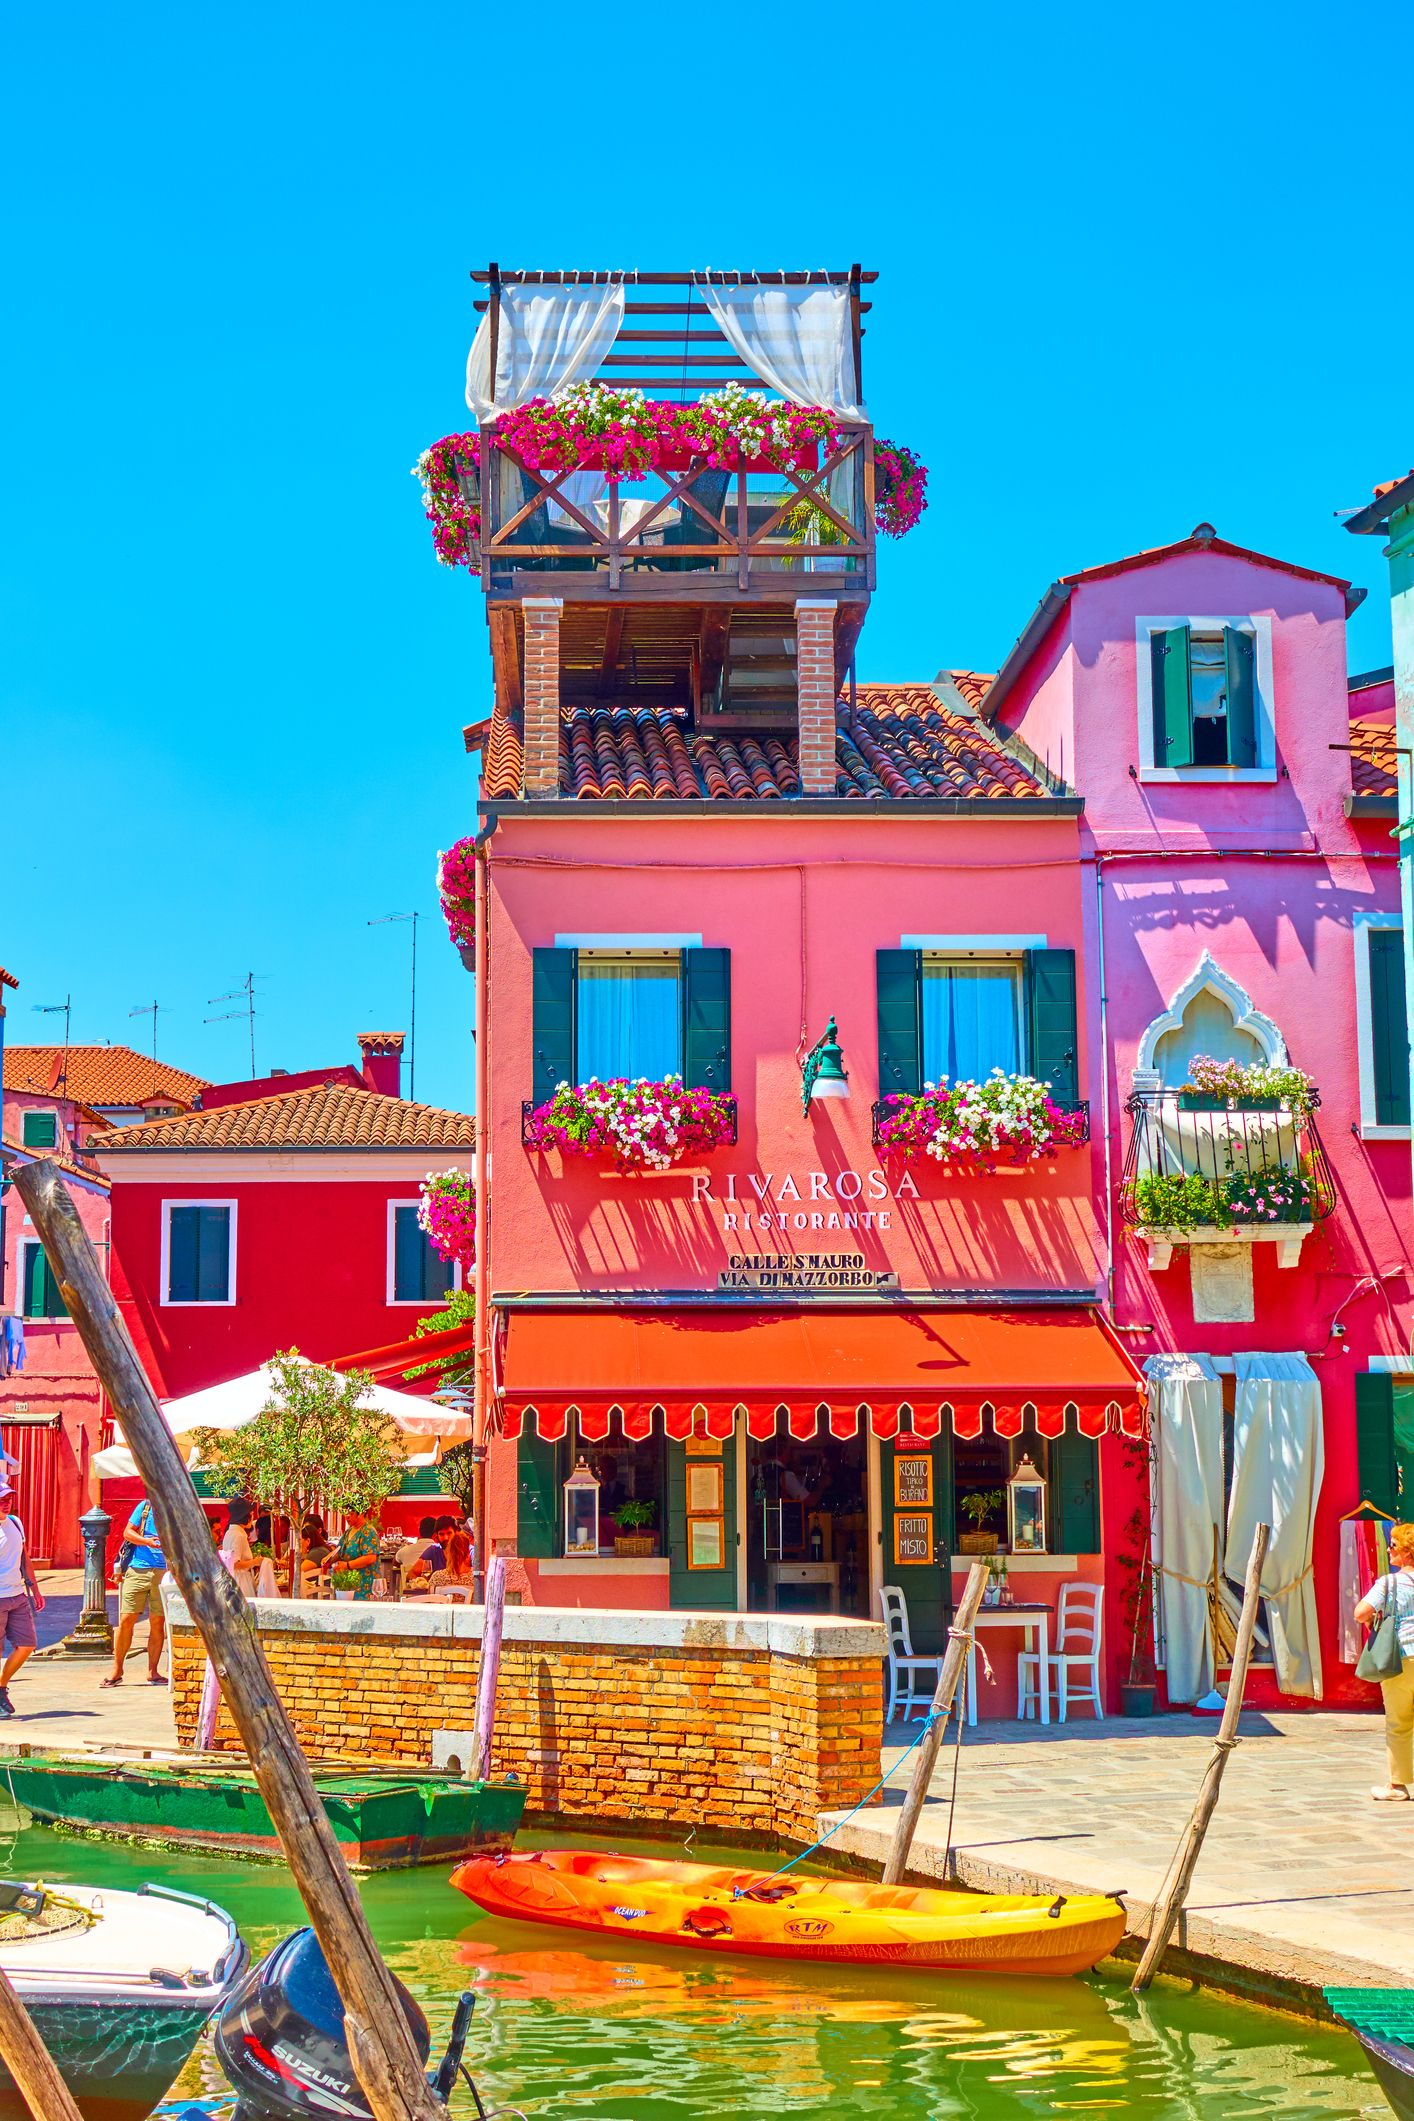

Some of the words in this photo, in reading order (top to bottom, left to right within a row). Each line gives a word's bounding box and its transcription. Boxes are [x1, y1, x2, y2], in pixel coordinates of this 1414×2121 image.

[690, 1170, 921, 1202] RIVAROSA
[723, 1212, 892, 1230] RISTORANTE
[729, 1255, 789, 1269] CALLE
[720, 1272, 750, 1286] VIA
[759, 1272, 778, 1286] DI
[782, 1271, 873, 1286] MAZZORBO
[899, 1461, 928, 1477] RISOTTO
[900, 1488, 928, 1501] BURANO
[899, 1518, 927, 1533] FRITTO
[900, 1538, 927, 1555] MISTO
[788, 1922, 828, 1933] RTM
[270, 2044, 351, 2094] SUZUKI
